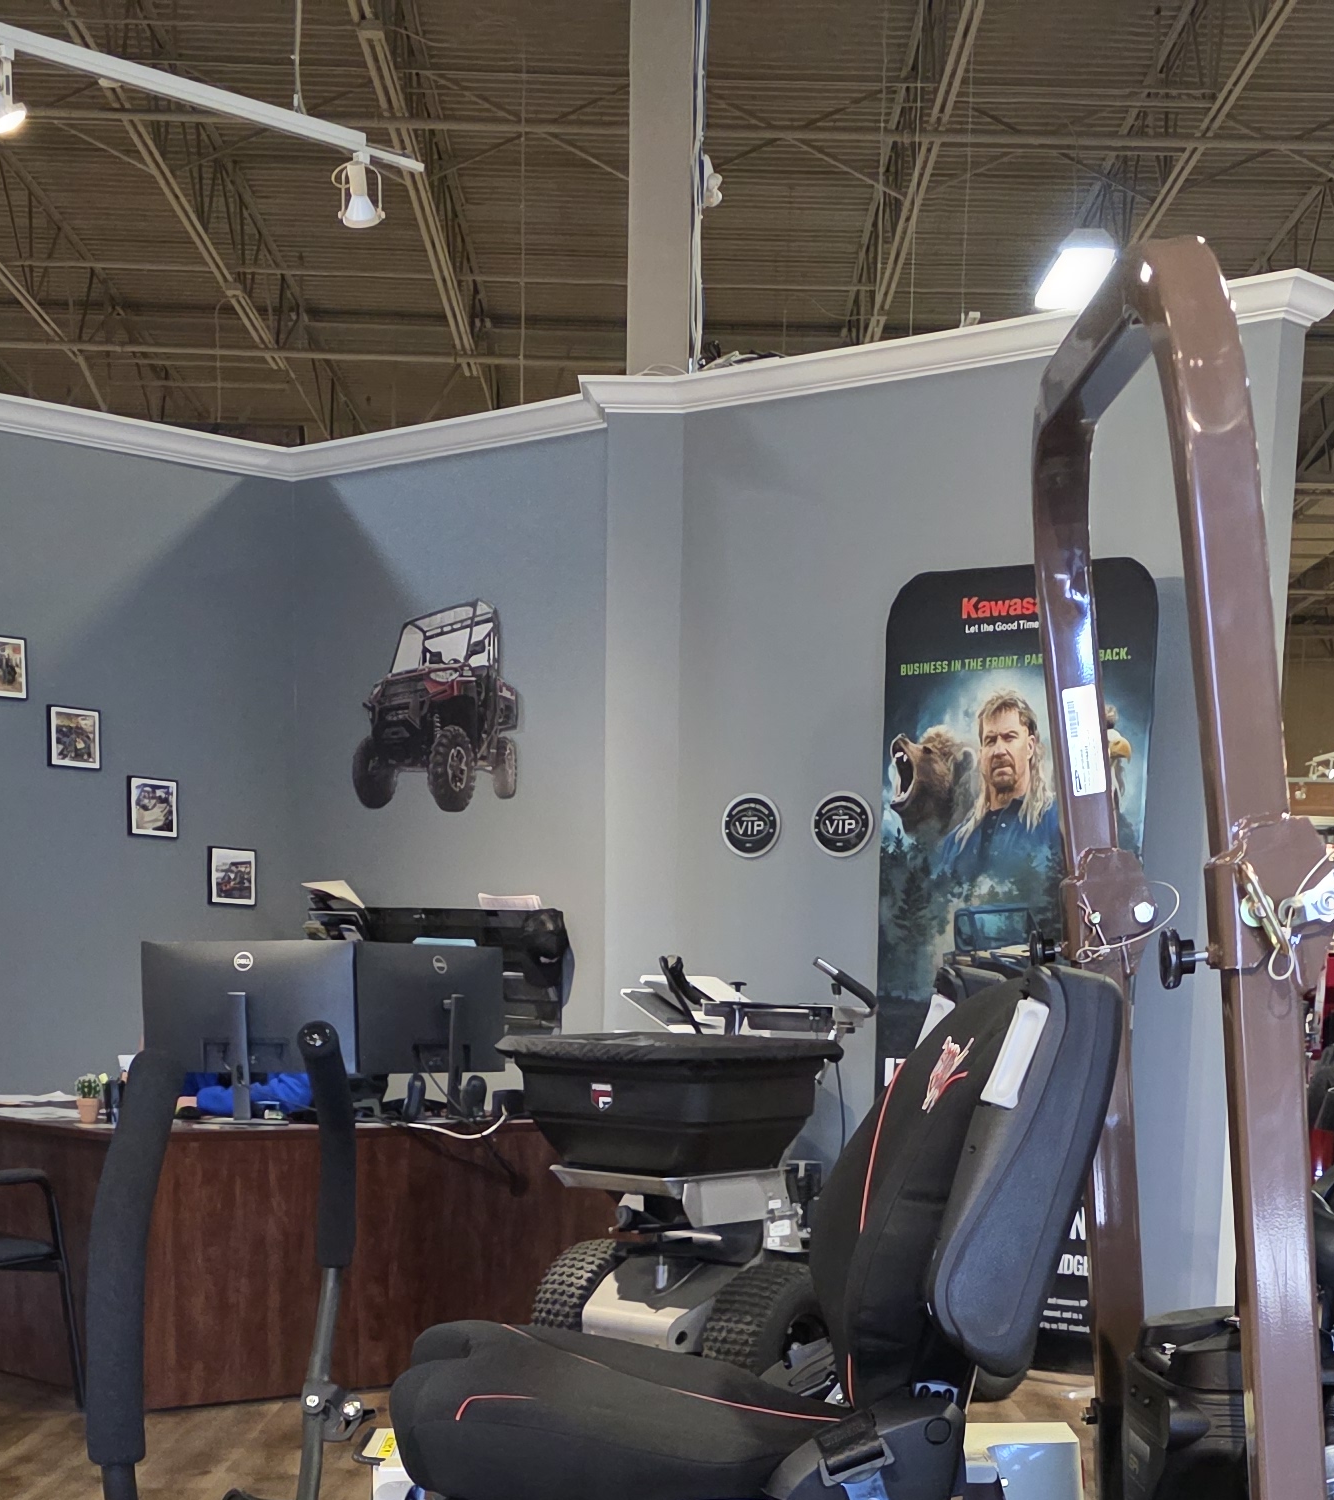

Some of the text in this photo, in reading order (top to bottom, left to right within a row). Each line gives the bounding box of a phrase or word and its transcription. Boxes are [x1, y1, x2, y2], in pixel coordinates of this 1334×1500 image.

[961, 597, 1040, 619] Kawas
[965, 620, 1040, 633] Let the Good Time
[900, 661, 949, 676] BUSINESS
[950, 660, 962, 672] IN
[964, 658, 984, 671] THE
[985, 655, 1022, 669] FRONT.
[1098, 646, 1132, 662] BACK.
[735, 820, 764, 835] VIP
[825, 819, 856, 834] VIP
